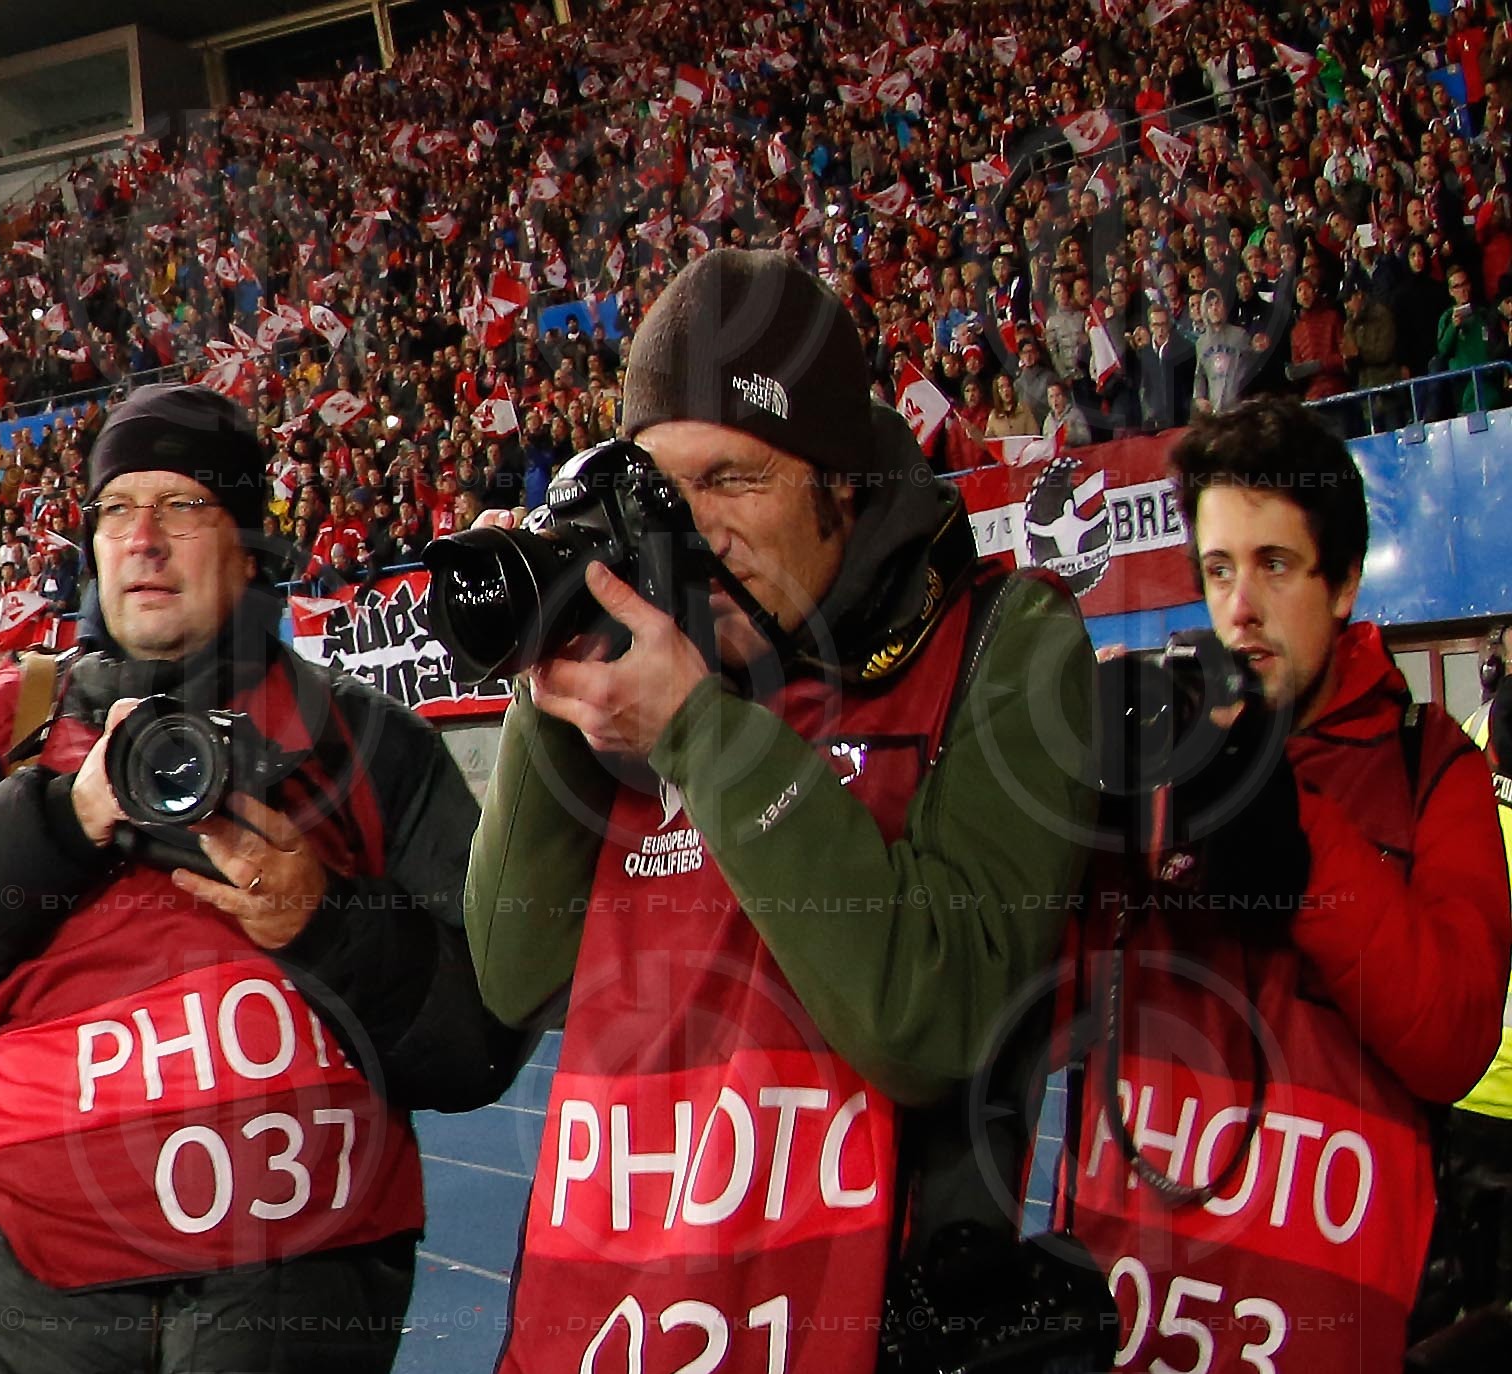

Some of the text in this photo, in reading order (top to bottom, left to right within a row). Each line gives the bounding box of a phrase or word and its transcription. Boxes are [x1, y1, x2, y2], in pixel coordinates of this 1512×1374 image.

[731, 375, 773, 403] NORTH
[753, 372, 774, 390] THE
[743, 390, 772, 412] FACE
[549, 485, 579, 507] Nikon
[1113, 488, 1181, 542] BRE
[641, 827, 702, 856] EUROPEAN
[624, 846, 704, 878] QUALIFIERS
[153, 1107, 357, 1235] 037
